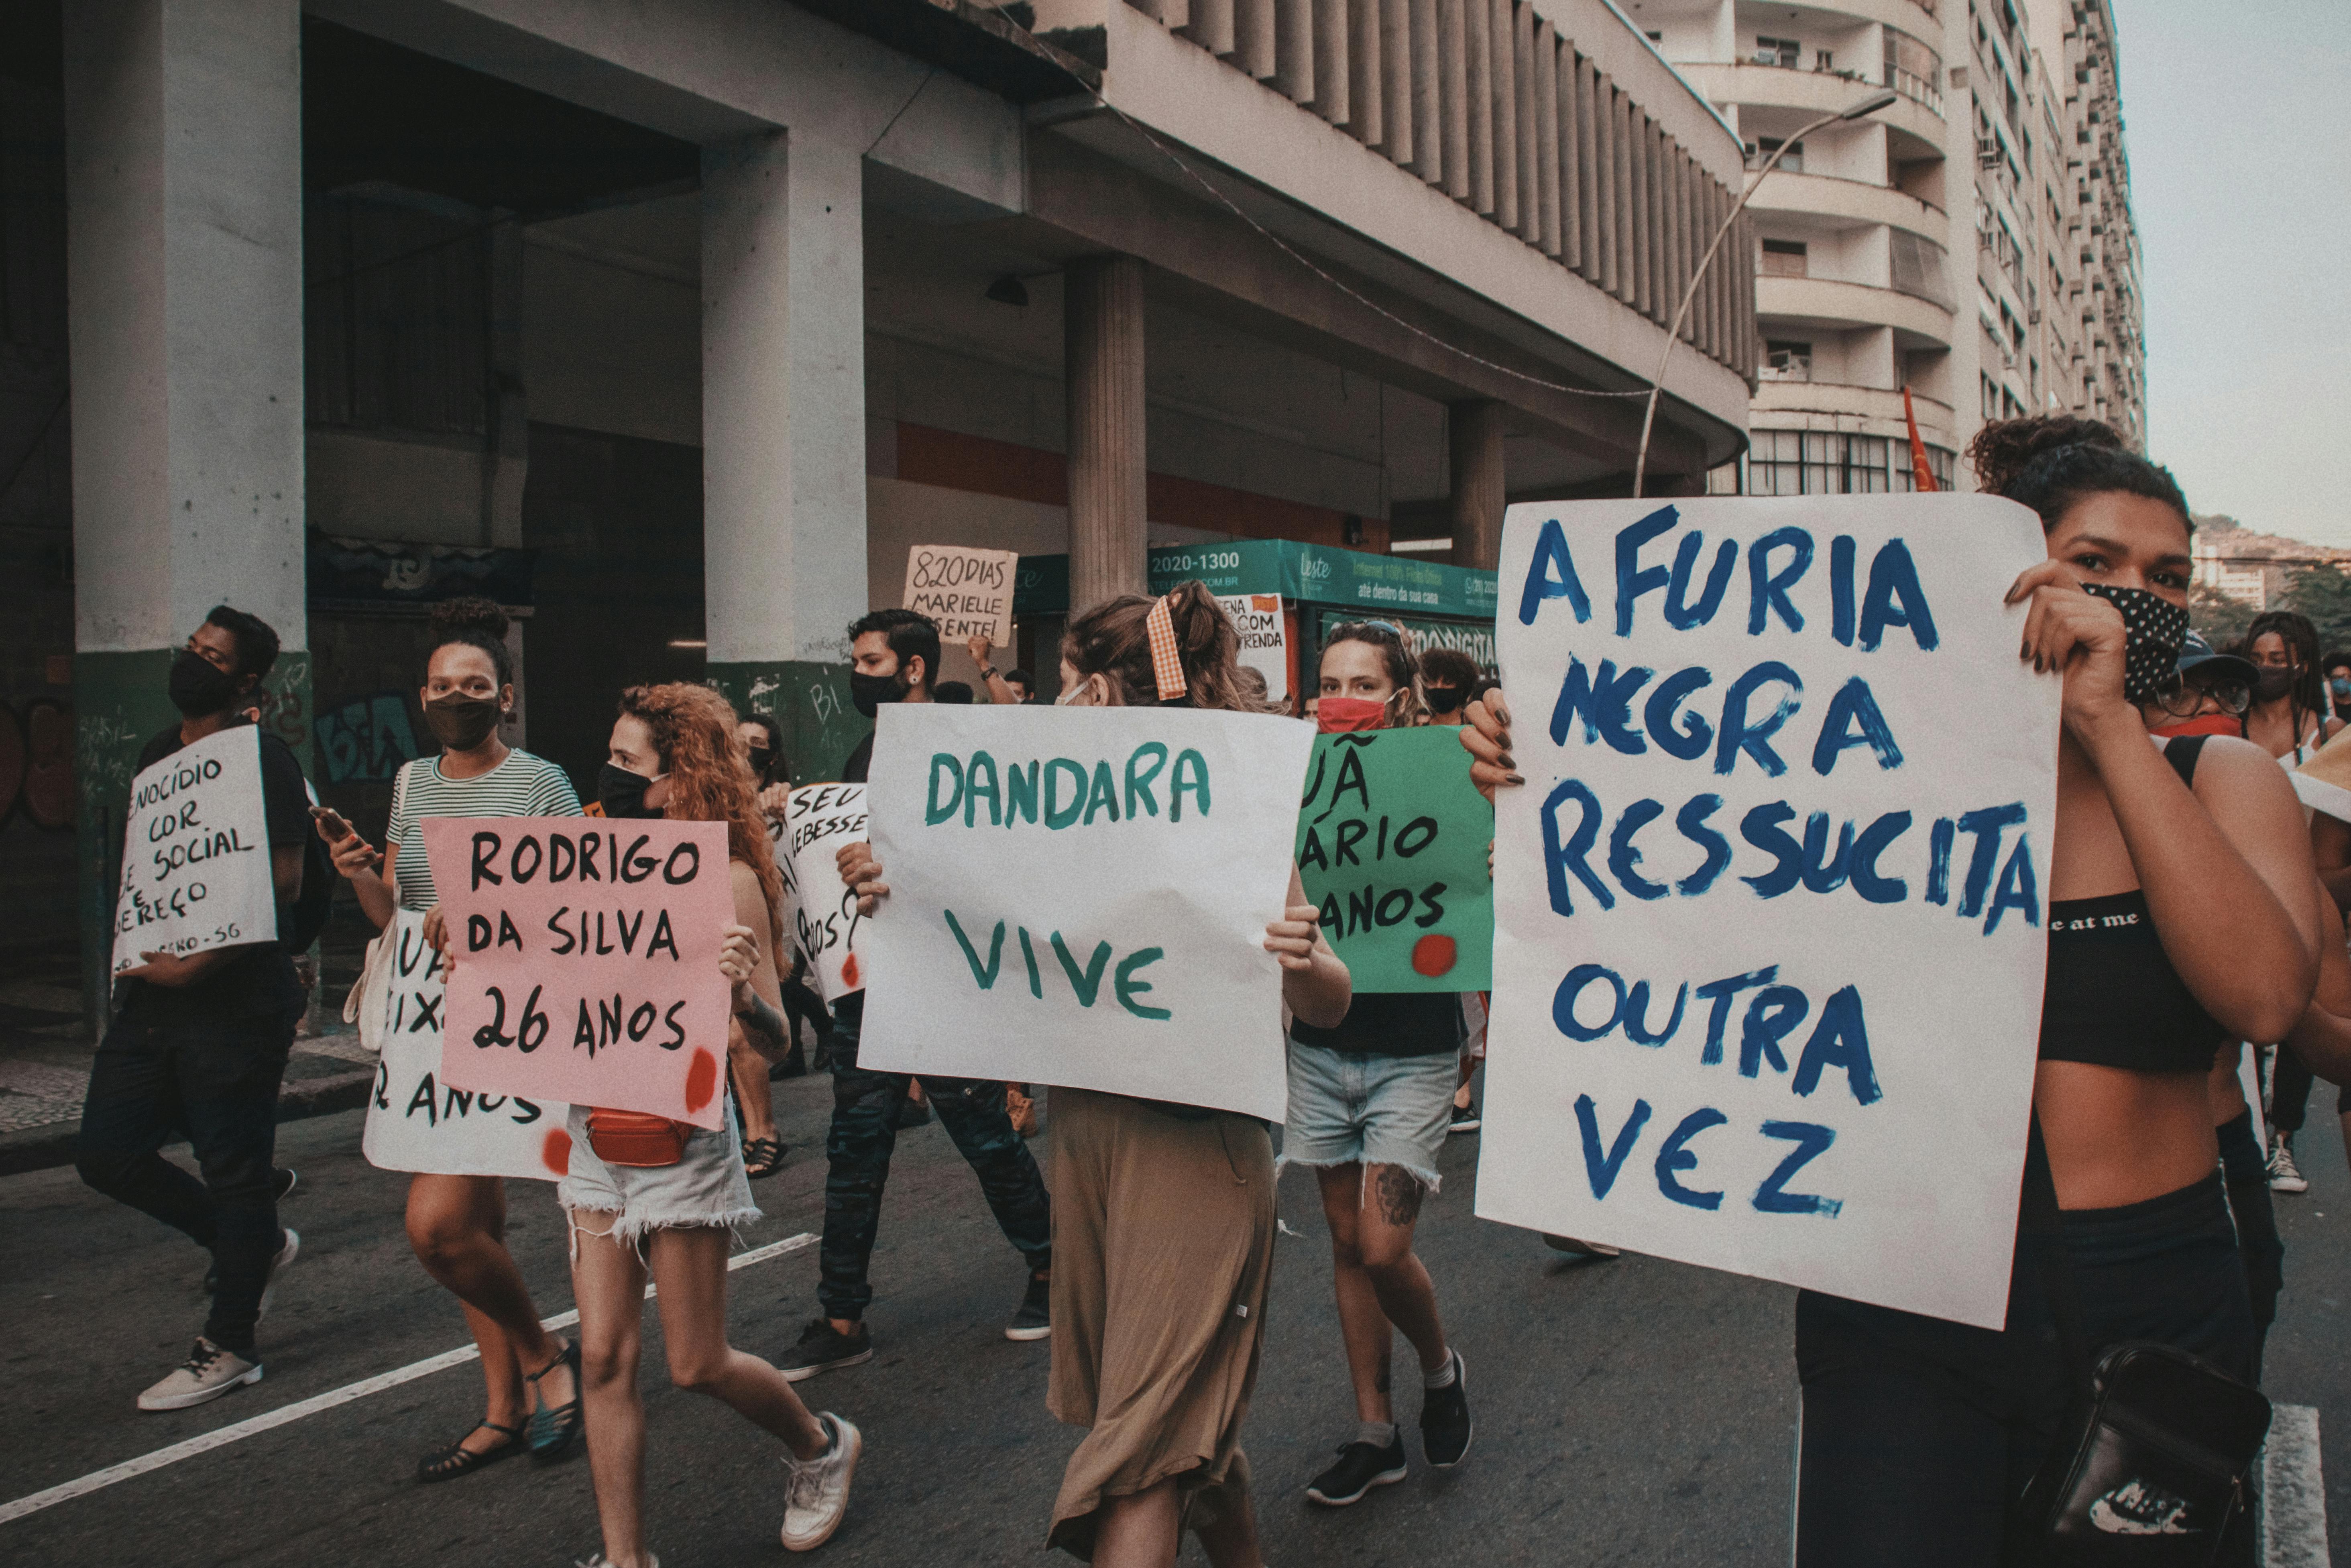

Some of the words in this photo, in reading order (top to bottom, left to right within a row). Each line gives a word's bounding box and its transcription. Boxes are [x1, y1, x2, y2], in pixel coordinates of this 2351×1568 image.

[1152, 552, 1240, 572] 2020-1300
[1518, 519, 1592, 625] A
[1614, 503, 1940, 653] FURIA
[912, 593, 1002, 615] MARIELLE
[1358, 581, 1371, 598] até
[1373, 582, 1397, 601] dentro
[1398, 584, 1408, 602] da
[1409, 591, 1422, 603] sua
[1423, 592, 1439, 605] casa
[1238, 614, 1274, 631] COM
[1244, 632, 1282, 649] RENDA
[1549, 651, 1904, 777] NEGRA
[791, 787, 864, 819] SEU
[924, 741, 1211, 831] DANDARA
[149, 800, 202, 843] COR
[471, 831, 700, 892] RODRIGO
[1540, 778, 2040, 937] RESSUCITA
[132, 890, 146, 908] E
[1319, 882, 1447, 943] ANOS
[2069, 916, 2097, 930] at
[2101, 913, 2139, 927] me
[468, 910, 523, 952] DA
[548, 906, 680, 962] SILVA
[944, 909, 1172, 1020] VIVE
[473, 984, 550, 1053] 26
[573, 993, 686, 1060] ANOS
[1552, 963, 1883, 1106] OUTRA
[1573, 1094, 1843, 1219] VEZ
